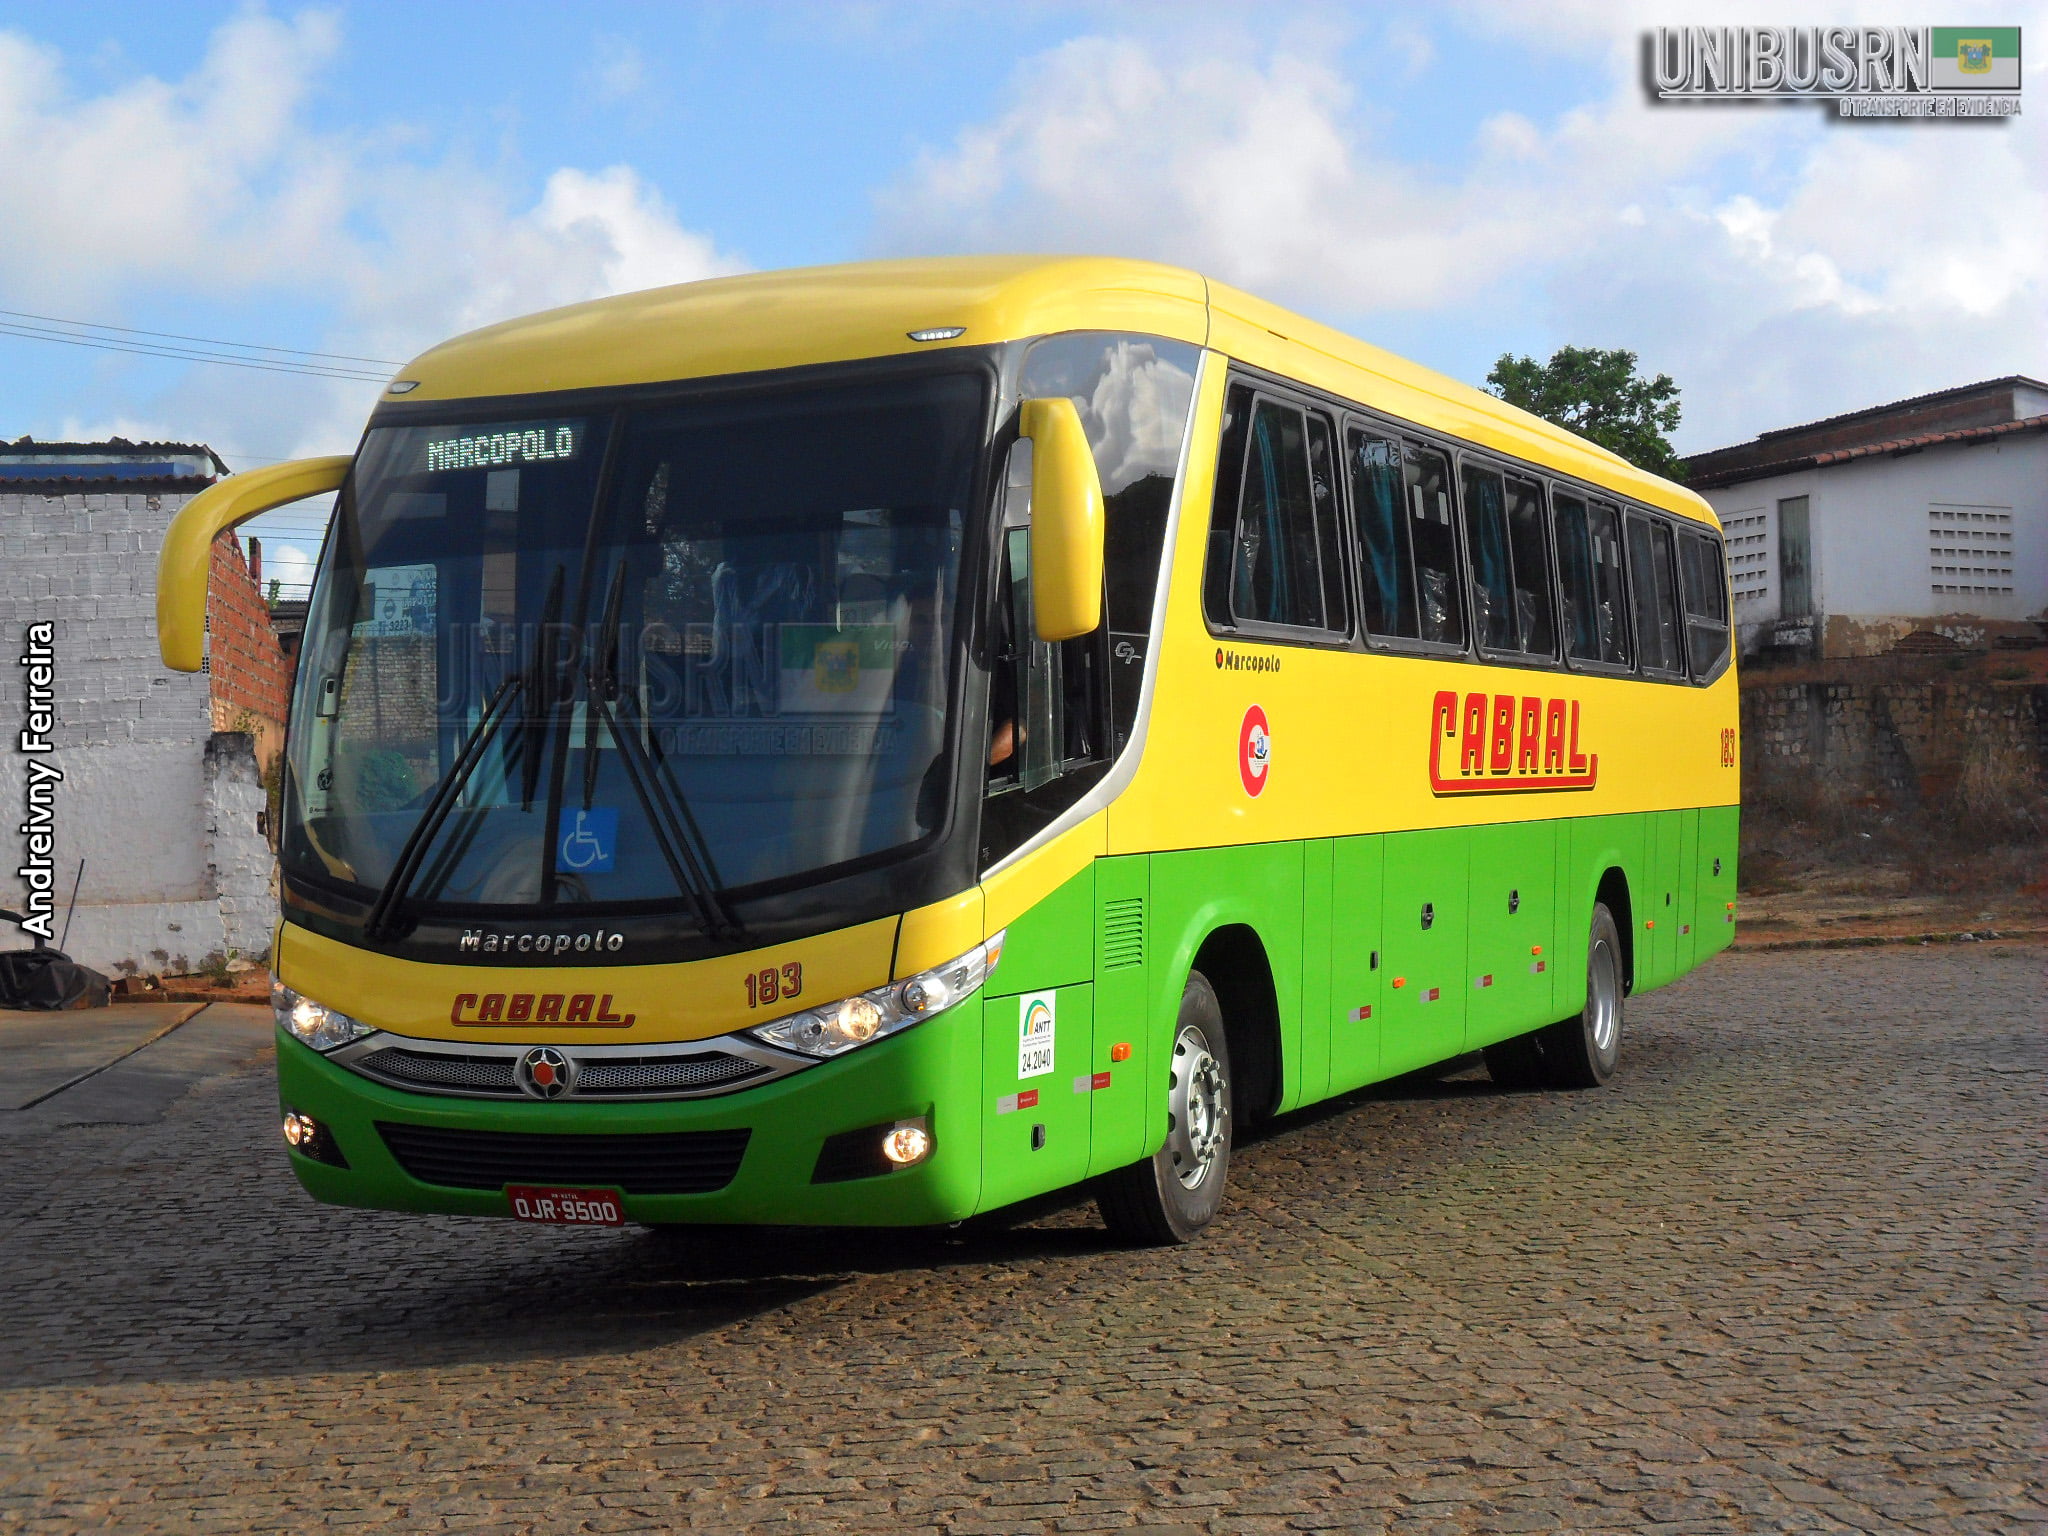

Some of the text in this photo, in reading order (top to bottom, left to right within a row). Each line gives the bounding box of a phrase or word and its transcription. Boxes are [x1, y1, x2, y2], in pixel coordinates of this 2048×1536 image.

[428, 427, 573, 471] MARCOPOLO
[1225, 651, 1281, 674] Marcopolo
[1429, 690, 1598, 798] CABRAL
[1720, 728, 1735, 768] 183
[460, 930, 625, 955] Marcopolo
[745, 961, 802, 1008] 183
[451, 993, 636, 1028] CABRAL
[1034, 1020, 1052, 1034] ANTT
[1022, 1048, 1051, 1073] 24.2040
